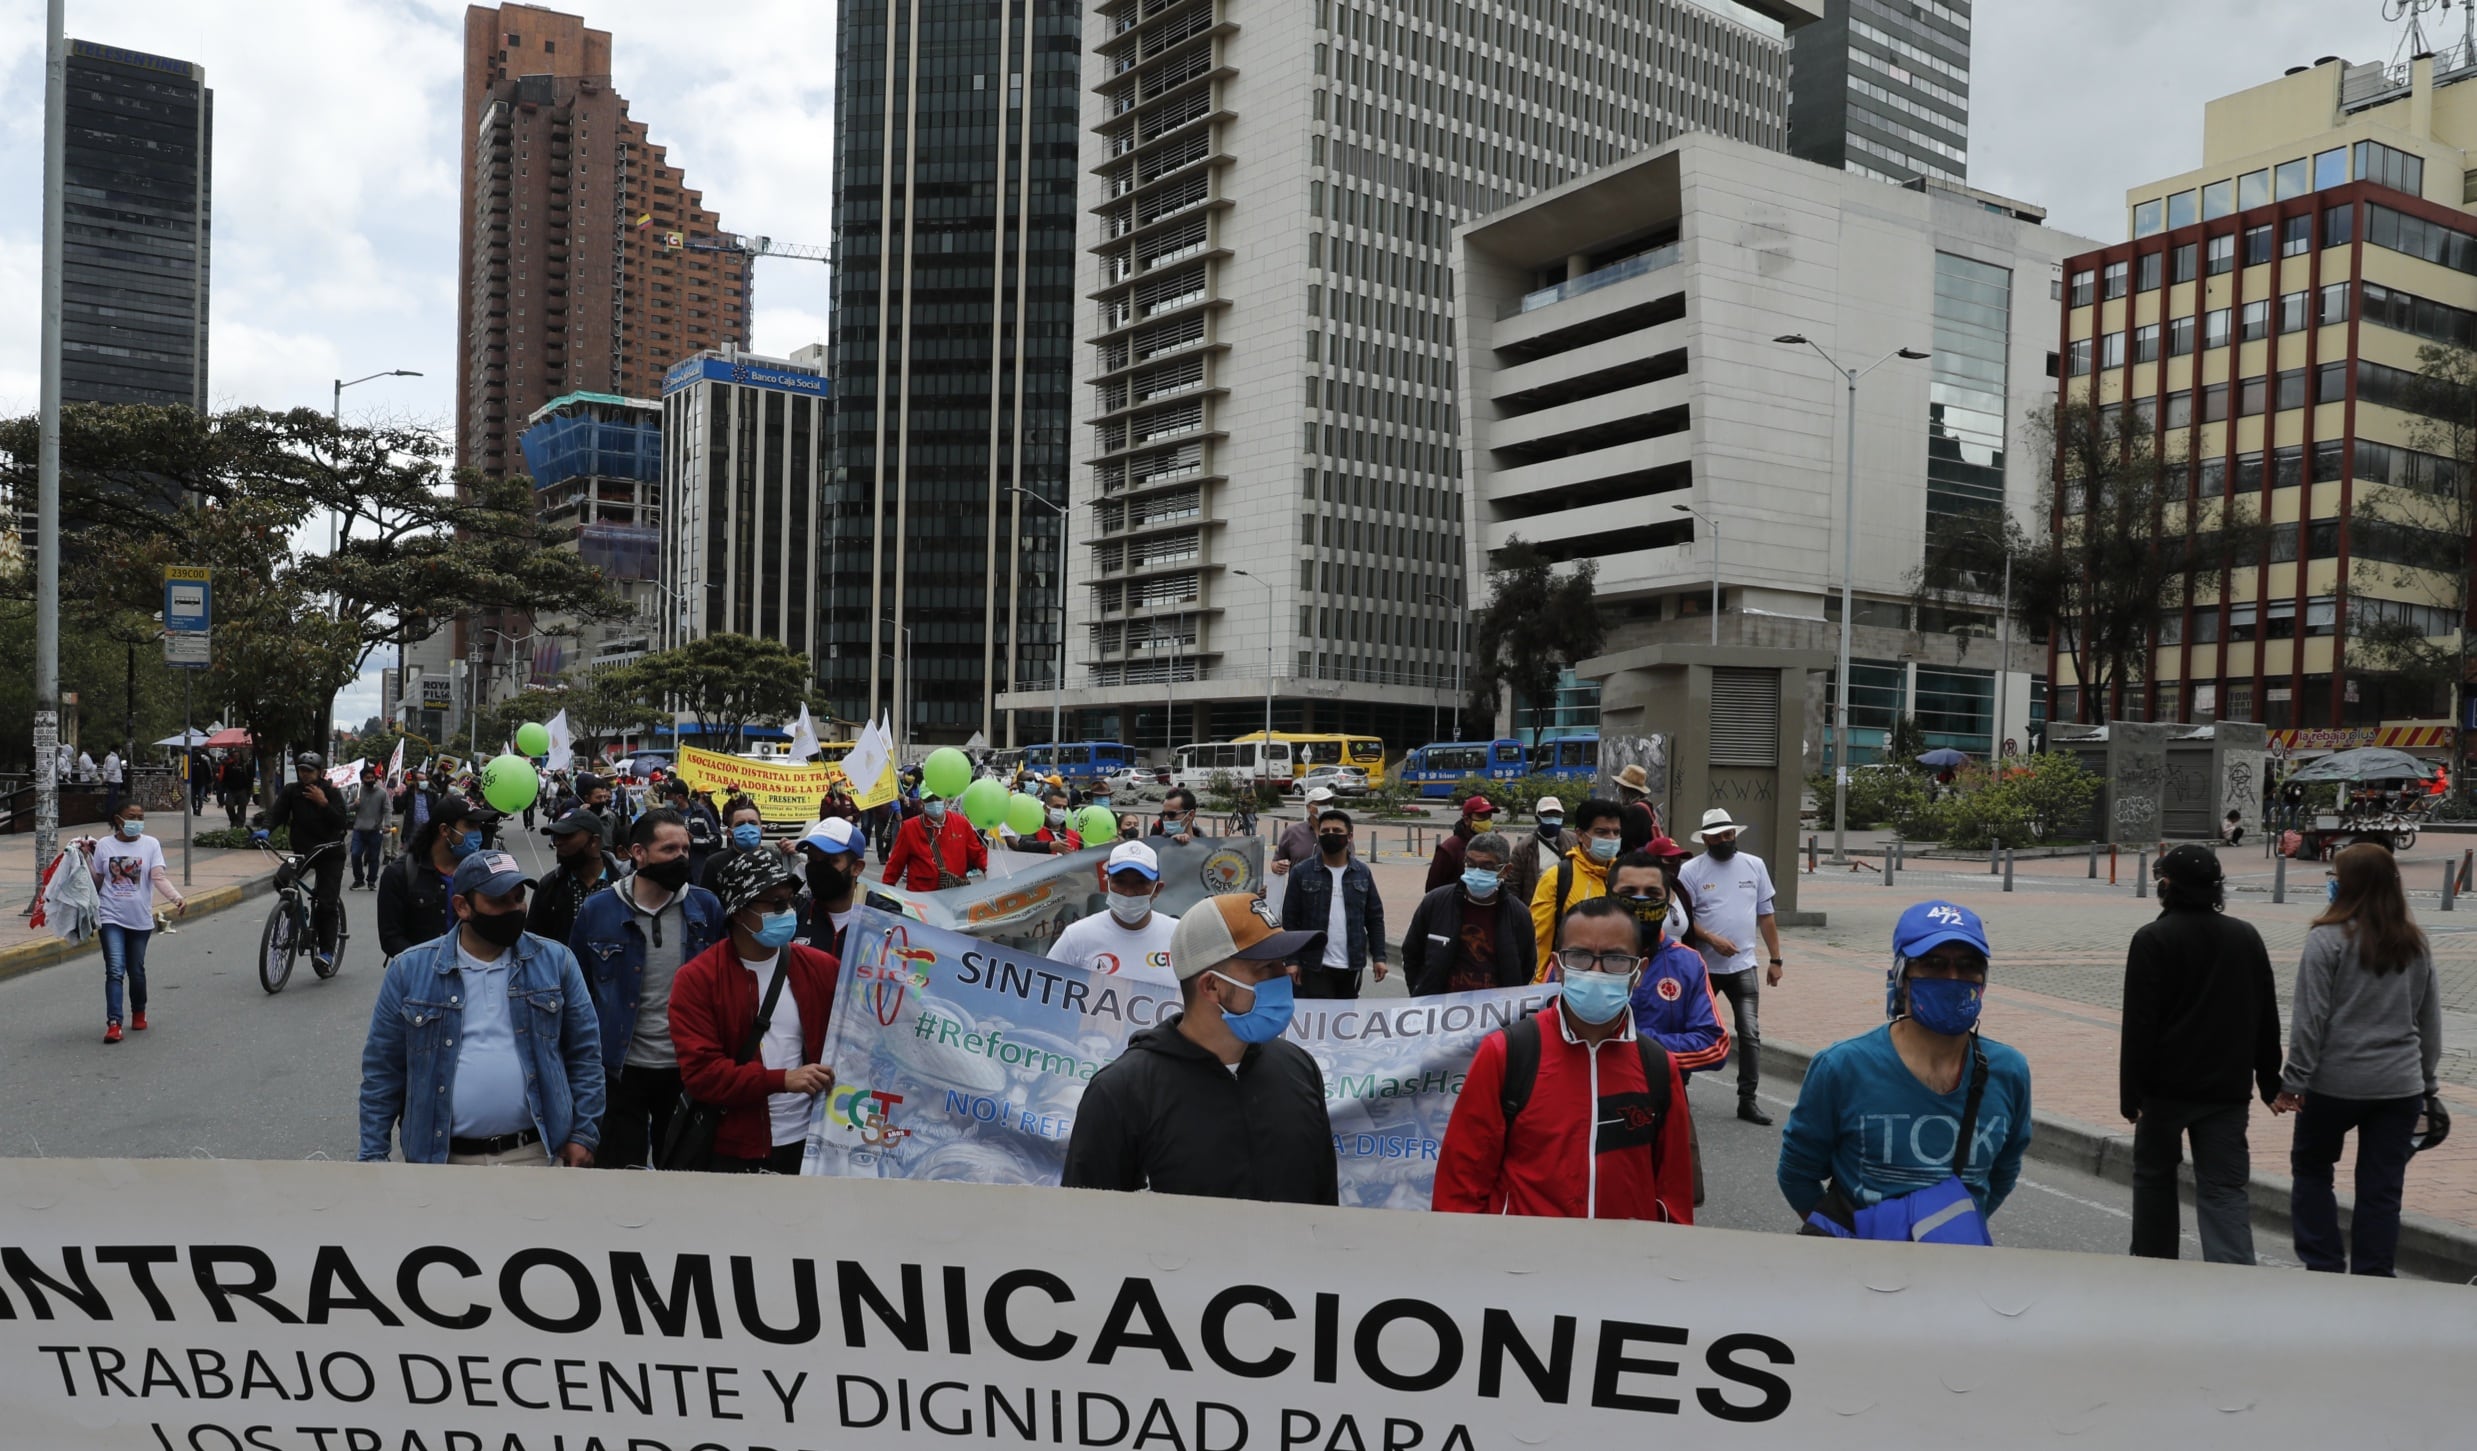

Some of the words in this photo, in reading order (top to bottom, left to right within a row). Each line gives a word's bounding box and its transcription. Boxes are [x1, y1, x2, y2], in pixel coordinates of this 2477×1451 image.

[751, 371, 777, 384] Banco
[778, 375, 795, 388] Caja
[796, 378, 821, 391] Social
[171, 568, 205, 578] 239C00
[423, 681, 450, 690] ROYA
[2298, 731, 2309, 742] la
[2311, 731, 2346, 744] rebaja
[2349, 729, 2377, 744] plus
[686, 753, 739, 774] ASOCIACIÓN
[740, 766, 791, 782] DISTRITAL
[793, 773, 807, 782] DE
[697, 769, 704, 779] Y
[784, 785, 797, 794] DE
[800, 784, 813, 793] LA
[1145, 951, 1170, 968] CGT
[825, 1084, 904, 1130] CGT
[944, 1088, 1012, 1128] NO!
[1019, 1110, 1071, 1138] REF
[1355, 1133, 1439, 1161] DISFR
[38, 1345, 376, 1403] TRABAJO
[398, 1352, 744, 1421] DECENTE
[761, 1368, 808, 1424] Y
[835, 1373, 1249, 1451] DIGNIDAD
